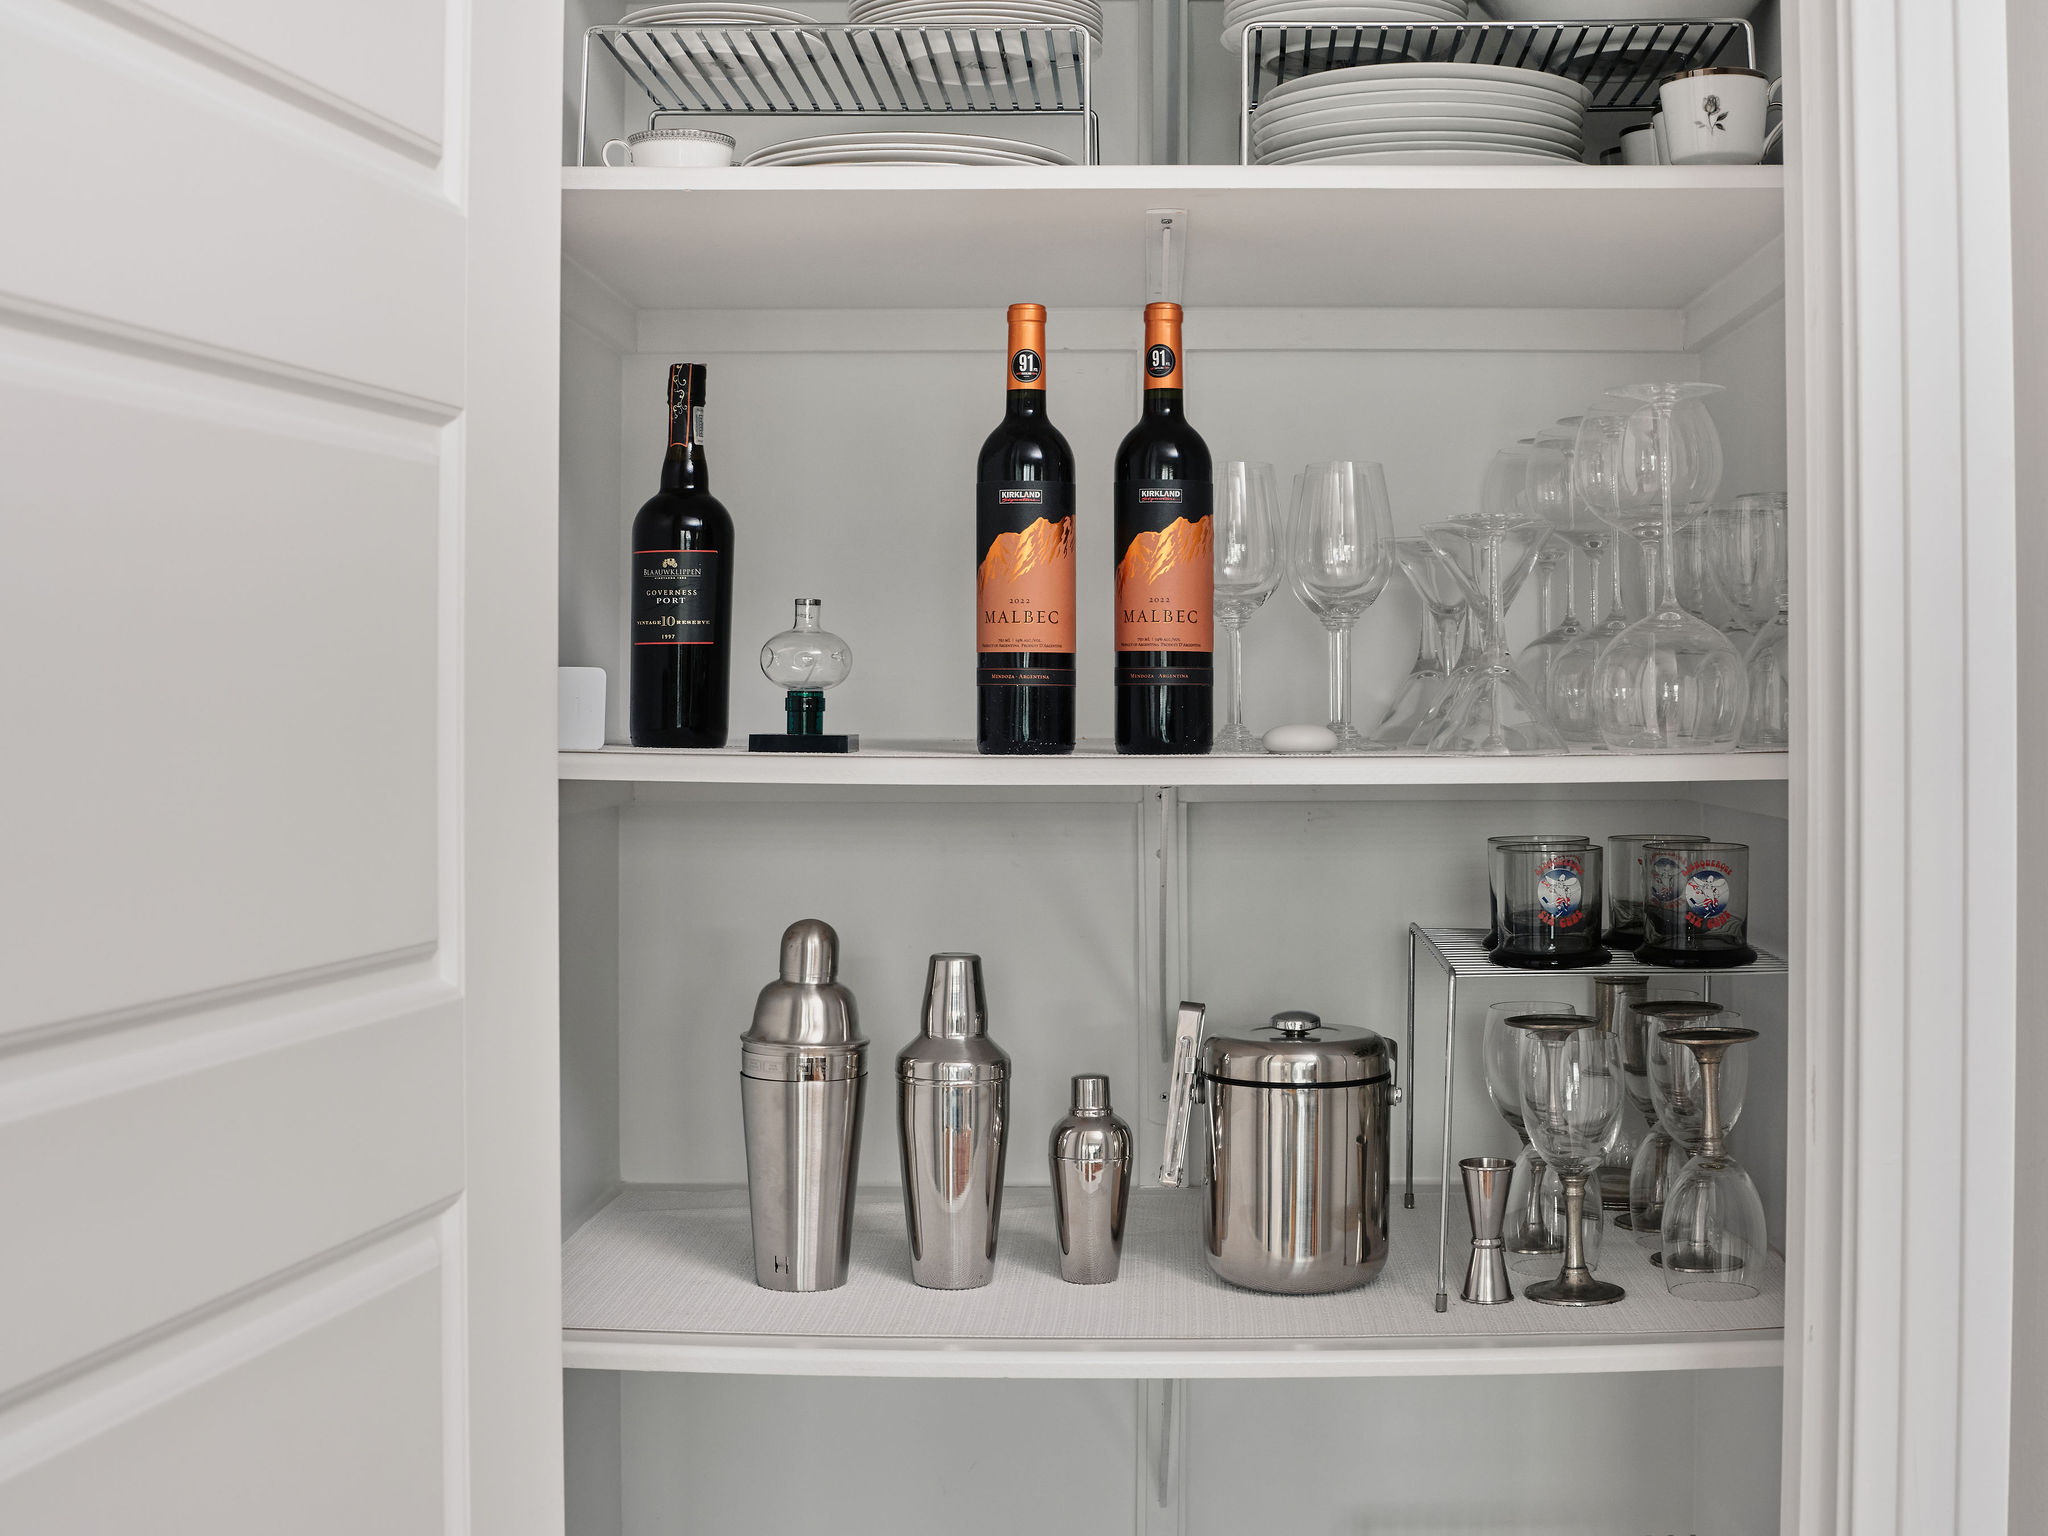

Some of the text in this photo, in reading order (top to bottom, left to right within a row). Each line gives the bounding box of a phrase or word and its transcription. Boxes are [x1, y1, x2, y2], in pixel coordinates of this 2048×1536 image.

[1019, 353, 1033, 372] 91
[1152, 349, 1166, 367] 91
[661, 616, 675, 627] 10
[985, 610, 1059, 624] MALBEC
[1123, 609, 1198, 624] MALBEC
